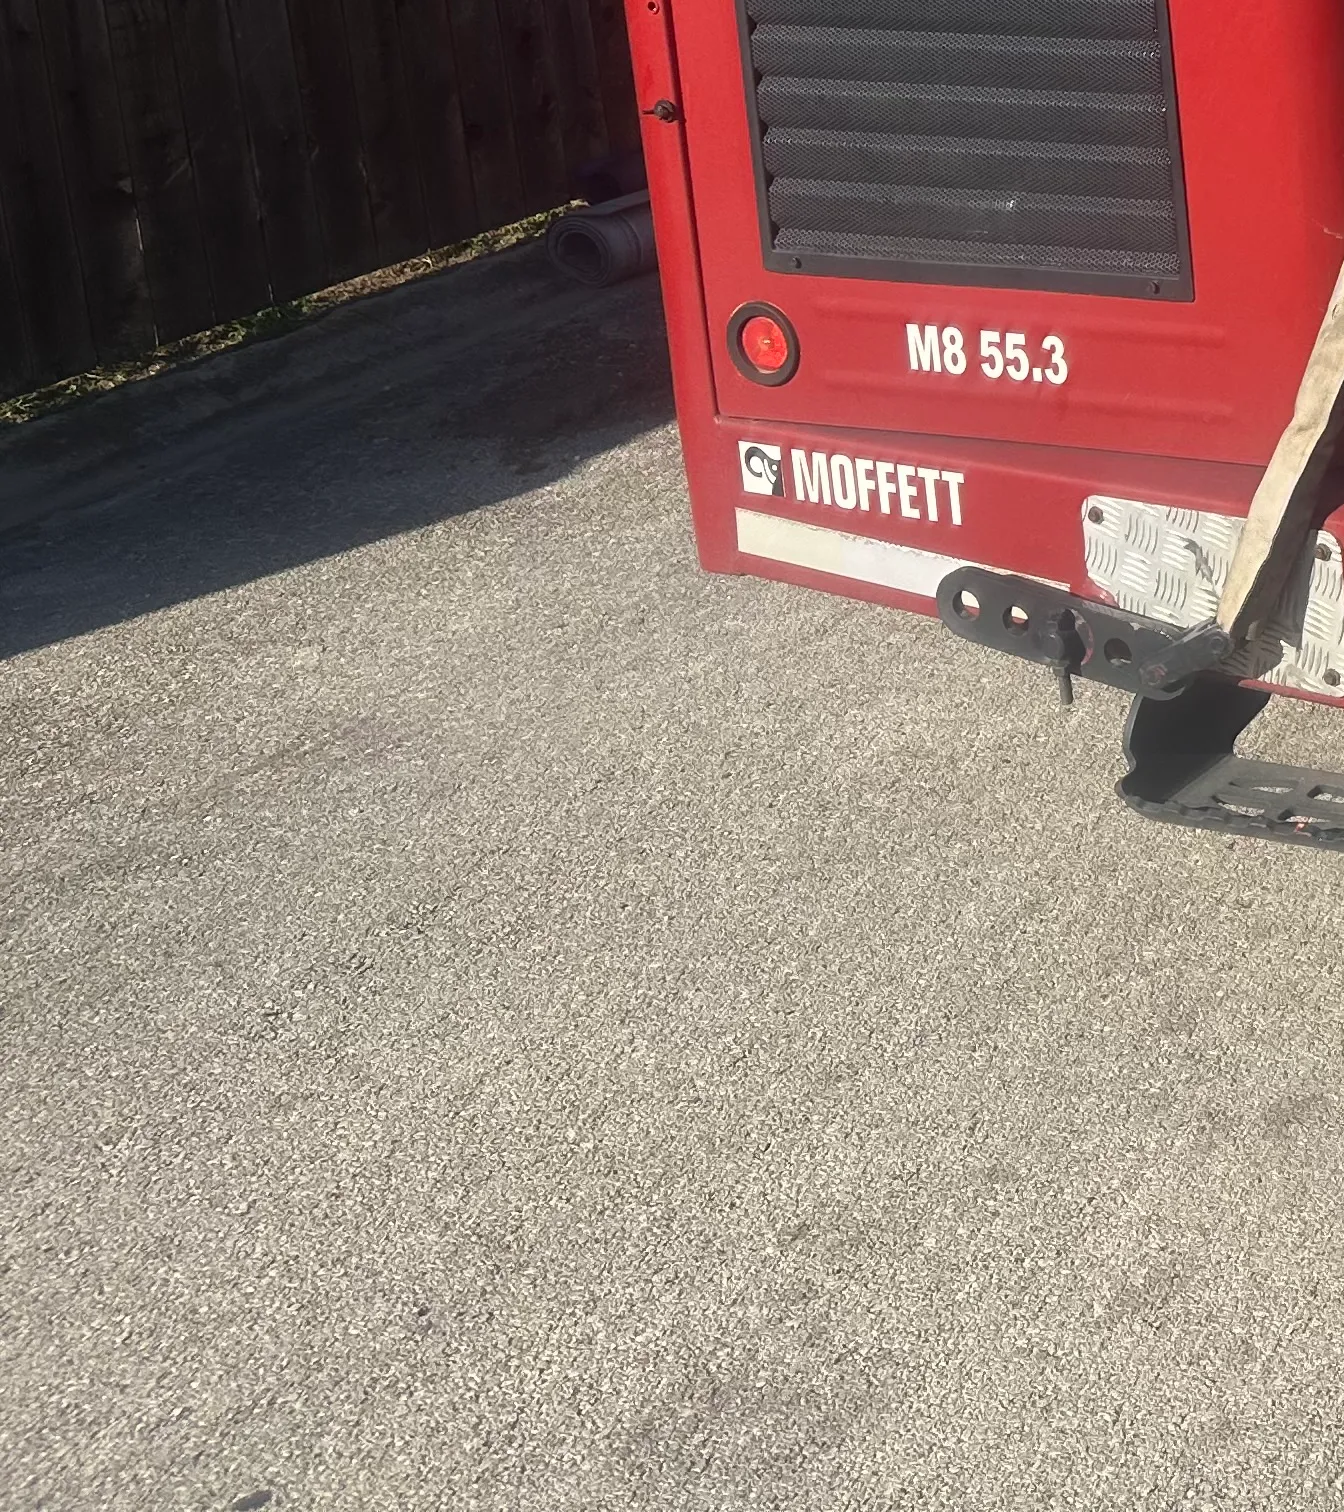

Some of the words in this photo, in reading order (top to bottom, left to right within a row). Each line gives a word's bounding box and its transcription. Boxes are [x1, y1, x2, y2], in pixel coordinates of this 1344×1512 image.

[905, 323, 967, 375] M8
[980, 329, 1069, 385] 55.3
[791, 448, 965, 526] MOFFETT
